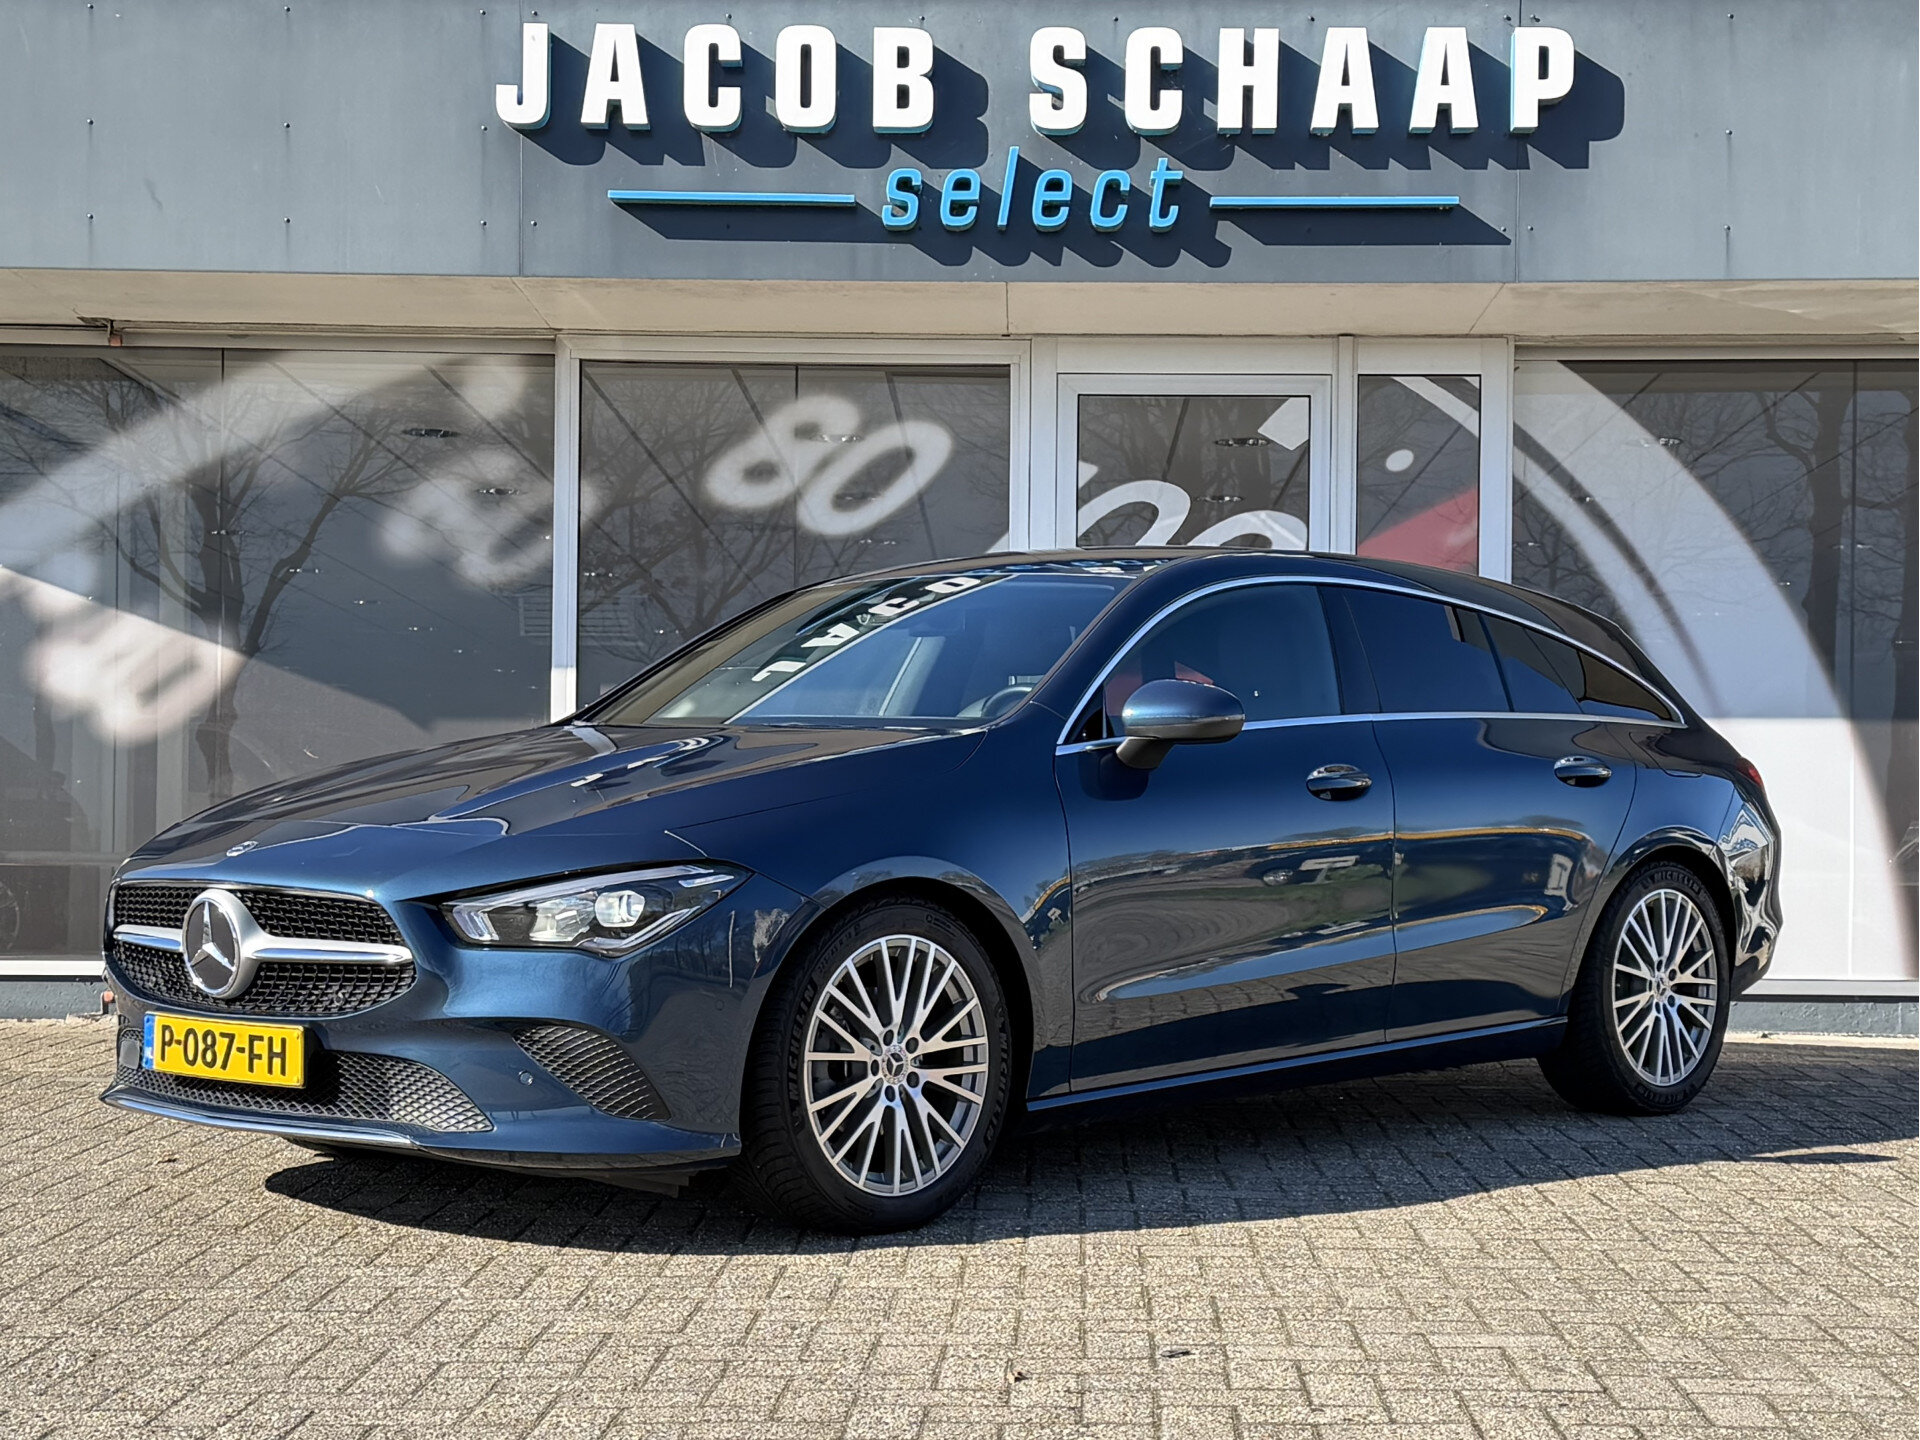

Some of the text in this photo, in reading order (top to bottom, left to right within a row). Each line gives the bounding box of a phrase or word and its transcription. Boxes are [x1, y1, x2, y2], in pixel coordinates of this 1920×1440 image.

[495, 21, 1575, 134] JACOB SCHAAP
[881, 145, 1183, 232] select
[705, 396, 953, 536] 80
[1653, 870, 1701, 894] MICHELIN
[160, 1024, 287, 1077] P-087-FH
[788, 983, 816, 1101] MICHELIN
[986, 1031, 1009, 1142] MICHELIN
